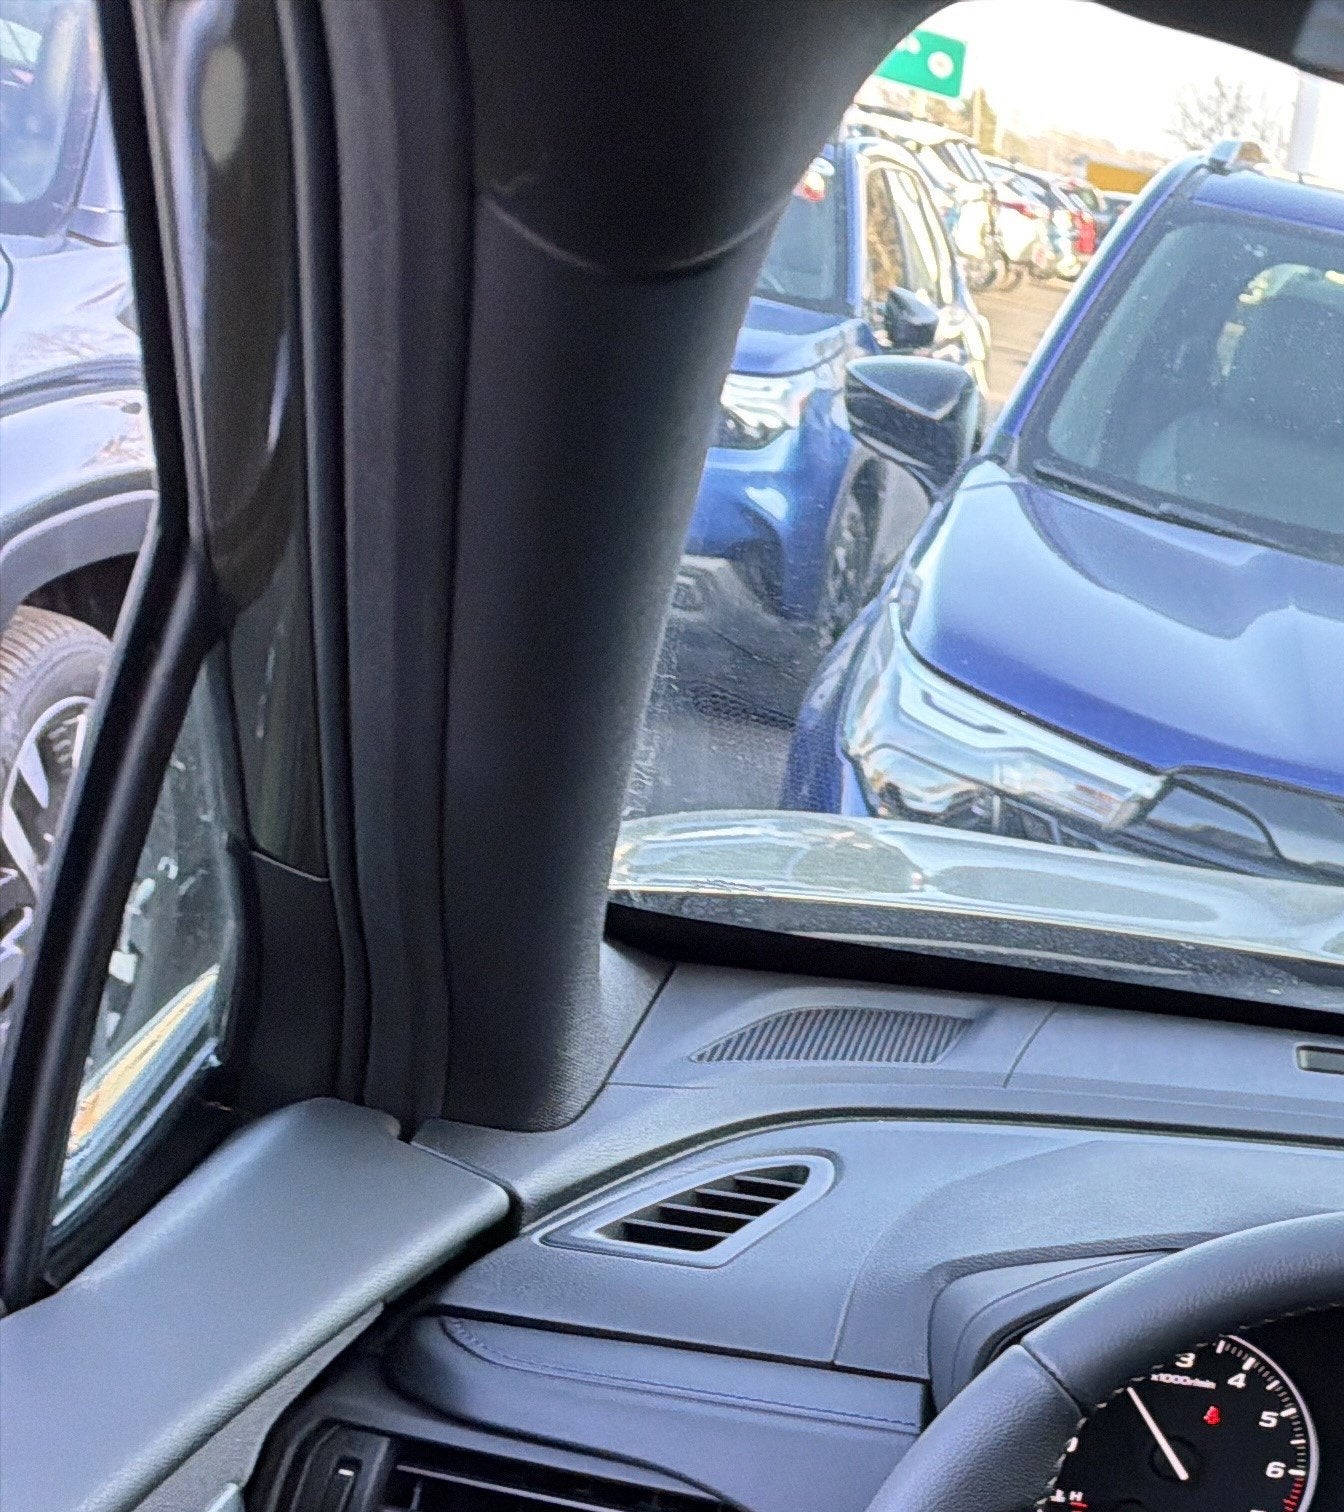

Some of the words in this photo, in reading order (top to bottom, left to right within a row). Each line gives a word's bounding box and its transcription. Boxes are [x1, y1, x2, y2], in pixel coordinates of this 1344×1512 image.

[1175, 1352, 1196, 1369] 3
[1227, 1373, 1247, 1389] 4
[1258, 1411, 1279, 1428] 5
[1265, 1462, 1287, 1479] 6
[1069, 1490, 1083, 1502] H
